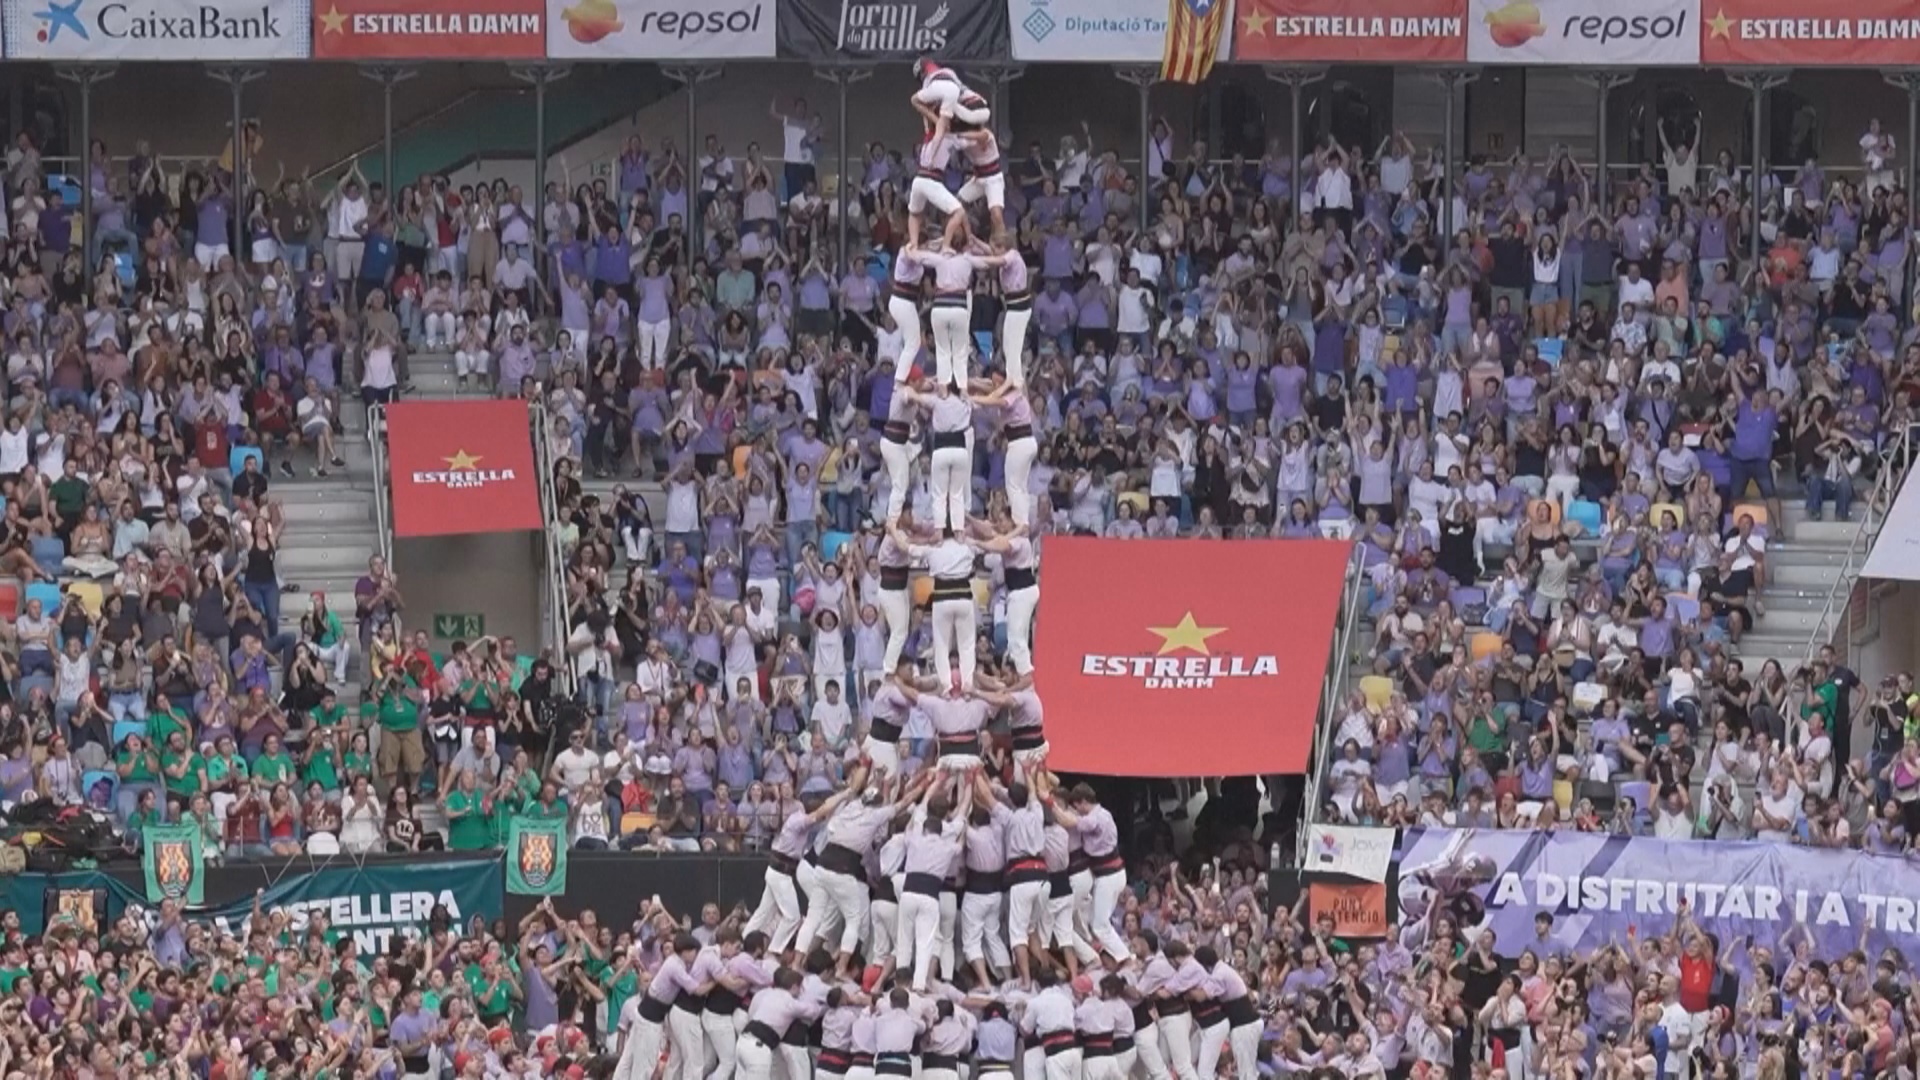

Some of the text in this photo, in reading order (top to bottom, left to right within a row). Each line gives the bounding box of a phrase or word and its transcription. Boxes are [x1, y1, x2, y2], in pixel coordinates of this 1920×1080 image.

[97, 4, 281, 39] CaixaBank
[353, 13, 539, 34] ESTRELLA DAMM
[641, 4, 761, 39] repsol
[1065, 17, 1140, 34] Diputació
[1275, 16, 1462, 37] ESTRELLA DAMM
[1563, 9, 1686, 44] repsol
[1740, 18, 1852, 39] ESTRELLA
[413, 469, 515, 483] ESTRELLA
[1081, 654, 1279, 678] ESTRELLA
[1144, 677, 1214, 689] DAMM
[1493, 871, 1920, 934] A DISFRUTAR I A TR
